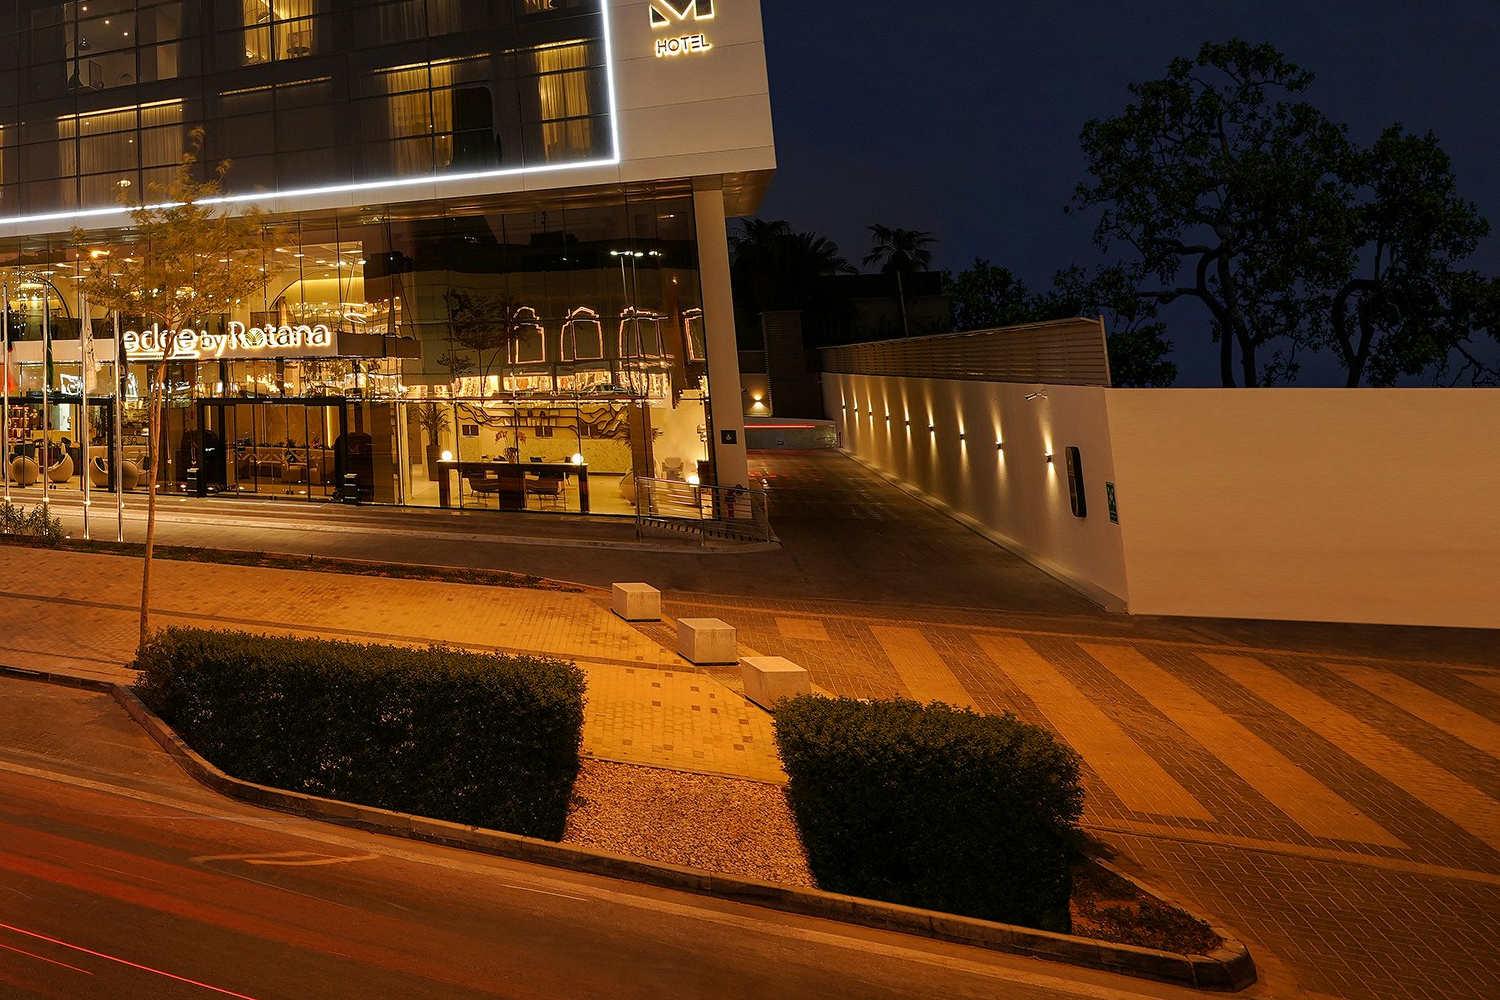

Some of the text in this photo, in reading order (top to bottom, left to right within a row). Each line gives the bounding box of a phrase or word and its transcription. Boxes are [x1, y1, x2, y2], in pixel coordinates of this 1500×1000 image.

[655, 33, 712, 57] HOTEL
[122, 321, 330, 360] edge by Rotana
